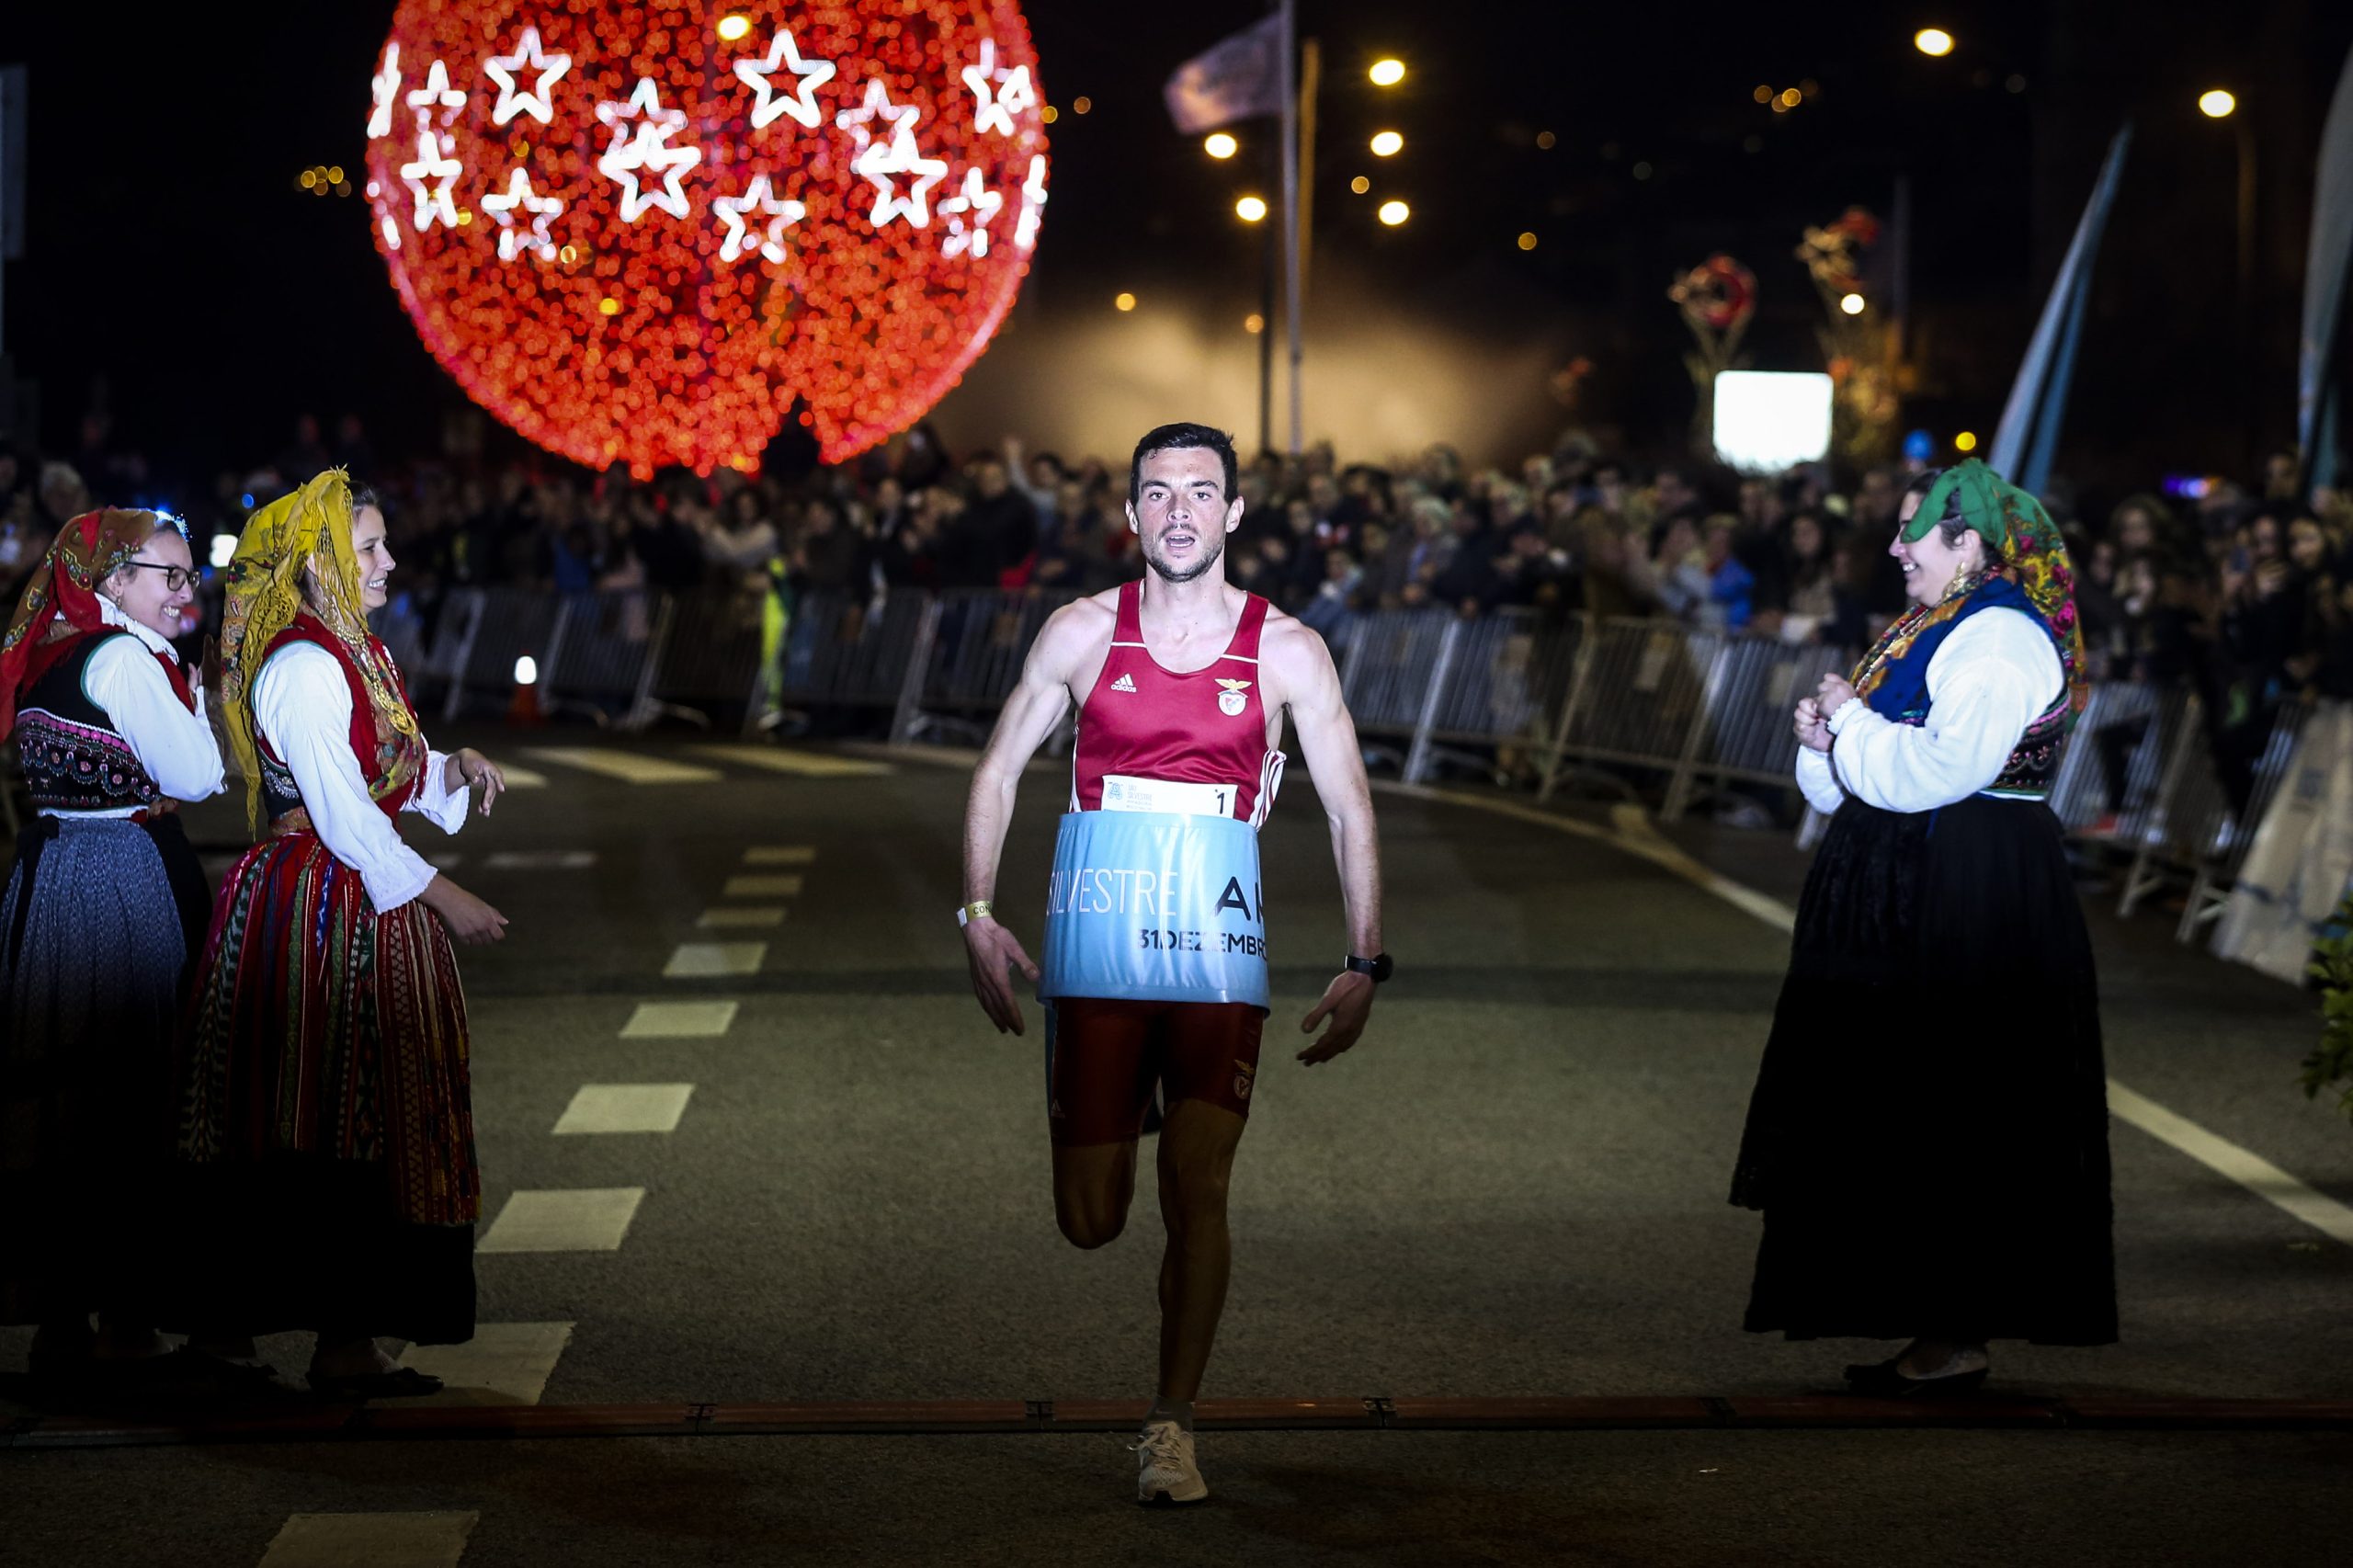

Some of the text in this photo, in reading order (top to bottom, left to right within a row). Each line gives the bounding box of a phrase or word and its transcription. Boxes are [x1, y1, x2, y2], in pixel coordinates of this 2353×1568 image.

[1110, 683, 1137, 693] adidas
[1217, 792, 1225, 814] 1
[1046, 869, 1178, 916] SILVESTRE
